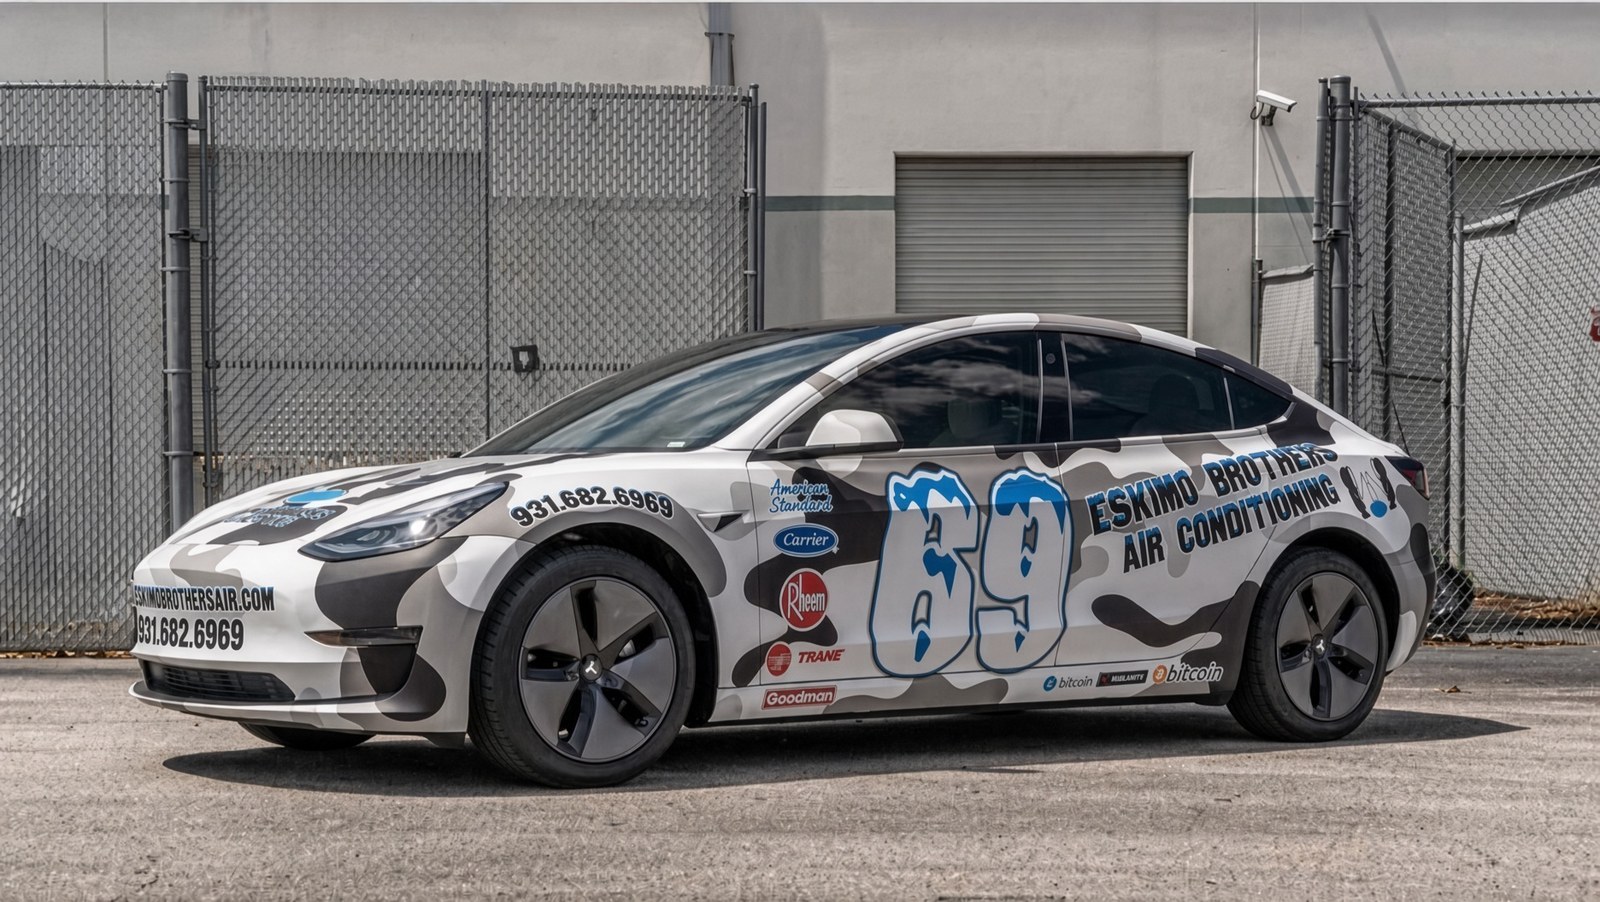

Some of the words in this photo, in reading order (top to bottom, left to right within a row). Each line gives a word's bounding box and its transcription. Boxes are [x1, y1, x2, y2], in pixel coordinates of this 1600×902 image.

[770, 479, 828, 497] American
[1086, 469, 1199, 535] ESKIMO
[1202, 443, 1339, 498] BROTHERS
[510, 486, 674, 527] 931.682.6969
[769, 496, 832, 513] Standard
[1123, 525, 1165, 574] AIR
[1175, 473, 1341, 554] CONDITIONING
[783, 532, 829, 547] Carrier
[869, 462, 1074, 678] 69
[134, 585, 275, 612] ESKIMOBROTHERSAIR.COM
[787, 573, 825, 621] Rheem
[138, 614, 245, 651] 931.682.6969
[798, 649, 845, 664] TRANE
[1058, 675, 1094, 689] bitcoin
[1166, 661, 1224, 683] bitcoin
[766, 690, 834, 706] Goodman
